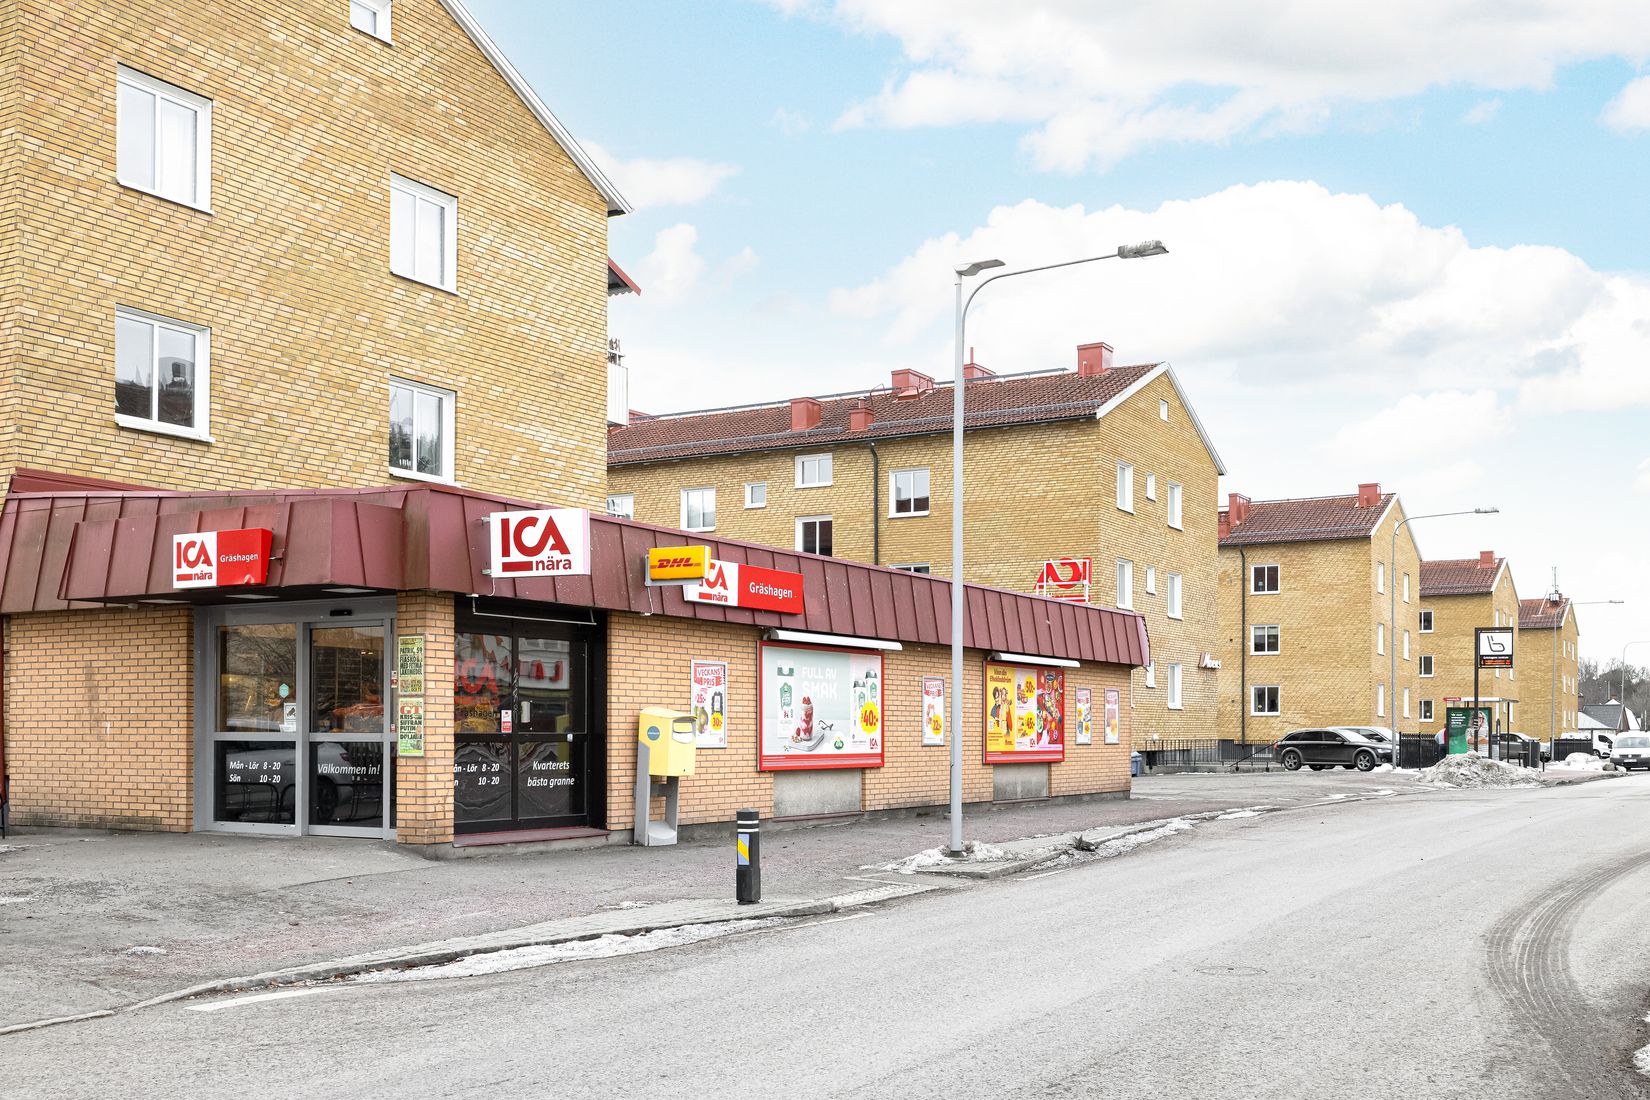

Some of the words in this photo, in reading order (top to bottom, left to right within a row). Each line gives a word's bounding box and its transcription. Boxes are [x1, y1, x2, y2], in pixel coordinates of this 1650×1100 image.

[501, 515, 571, 557] ICA
[176, 540, 213, 569] ICA
[220, 553, 259, 563] Gräshagen
[536, 556, 572, 571] nära
[657, 557, 694, 569] DHL
[194, 571, 213, 581] nära
[699, 562, 728, 590] CA
[750, 582, 793, 599] Gräshagen
[712, 592, 728, 602] nära
[802, 666, 823, 680] FULL
[825, 667, 837, 680] AV
[802, 680, 839, 701] SMAK
[400, 705, 422, 714] GT
[229, 760, 244, 770] Mån
[249, 761, 260, 770] Lör
[263, 761, 268, 770] 8
[272, 761, 281, 770] 20
[318, 763, 367, 774] Välkommen
[368, 763, 380, 775] in!
[467, 763, 478, 772] Lör
[481, 763, 487, 772] 8
[491, 763, 500, 772] 20
[532, 760, 570, 771] Kvarterets
[229, 773, 241, 782] Sön
[259, 774, 268, 783] 10
[272, 774, 281, 783] 20
[478, 776, 487, 785] 10
[491, 776, 500, 785] 20
[527, 776, 547, 787] bästa
[549, 776, 575, 789] granne
